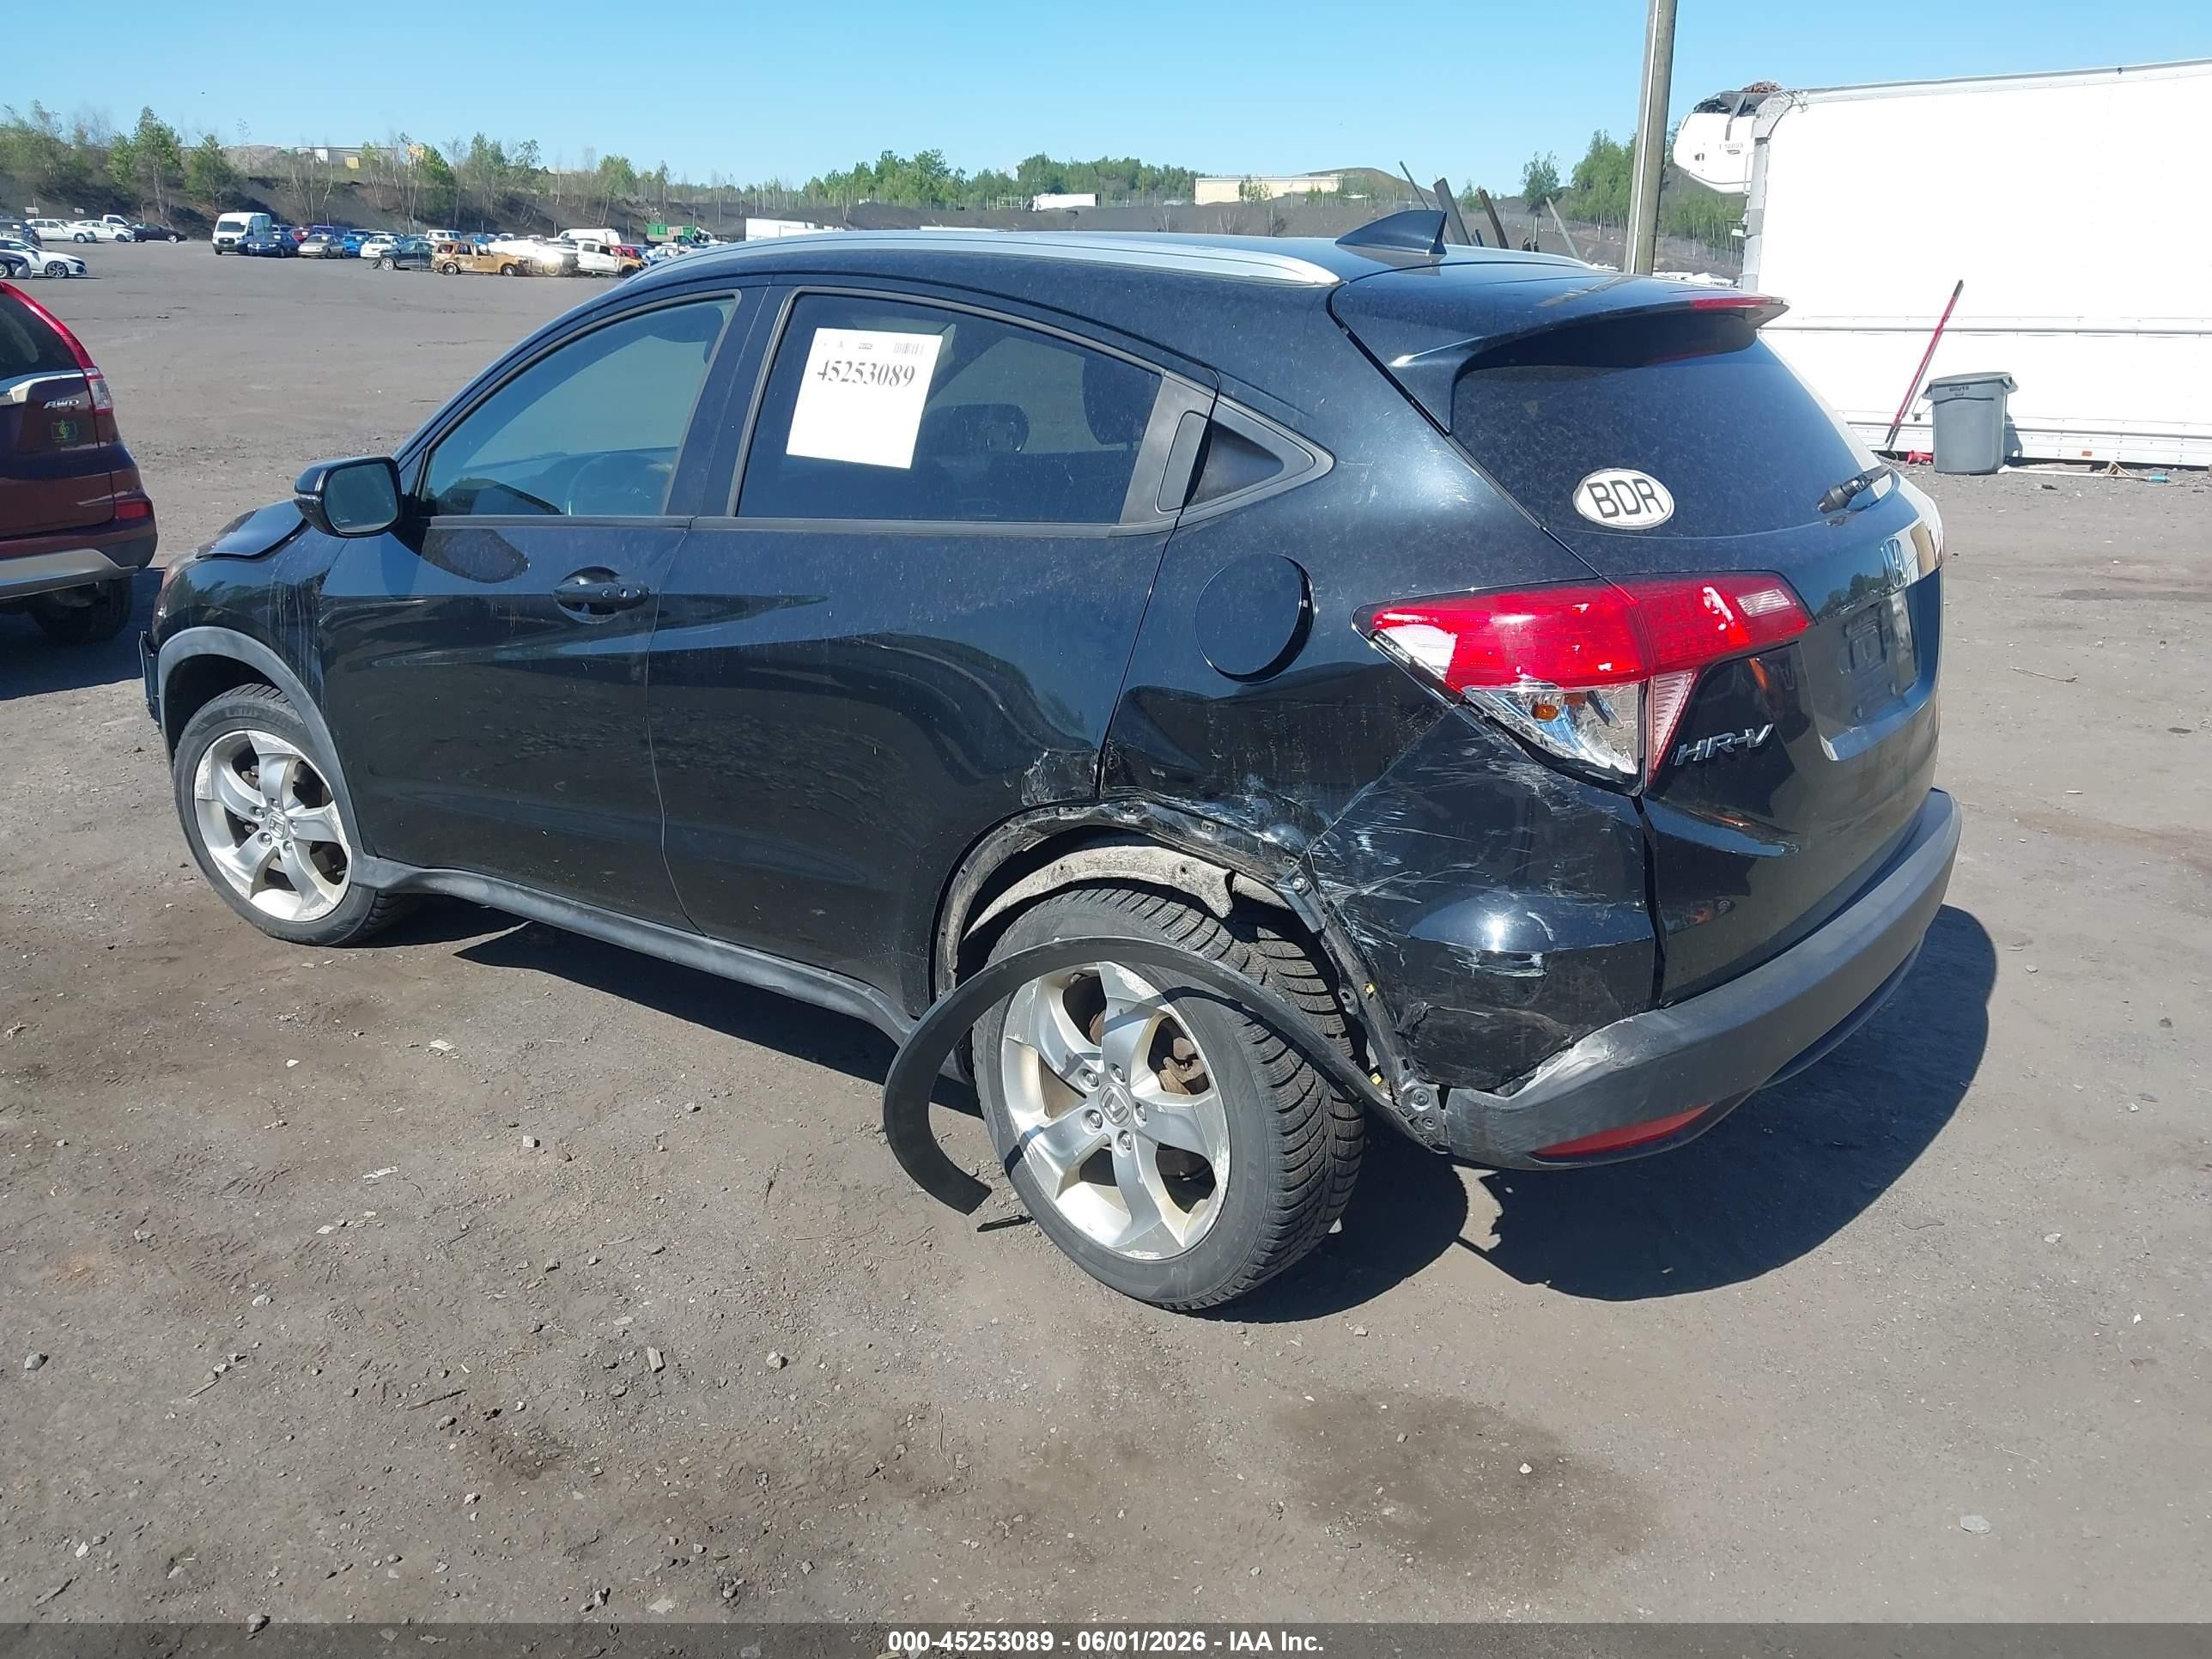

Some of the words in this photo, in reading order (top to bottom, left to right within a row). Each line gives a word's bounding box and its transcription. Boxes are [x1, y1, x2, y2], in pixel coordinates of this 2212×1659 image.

[817, 359, 916, 387] 45253089
[42, 399, 81, 410] AWD
[1586, 478, 1666, 519] BDR
[1674, 723, 1774, 766] HR-V
